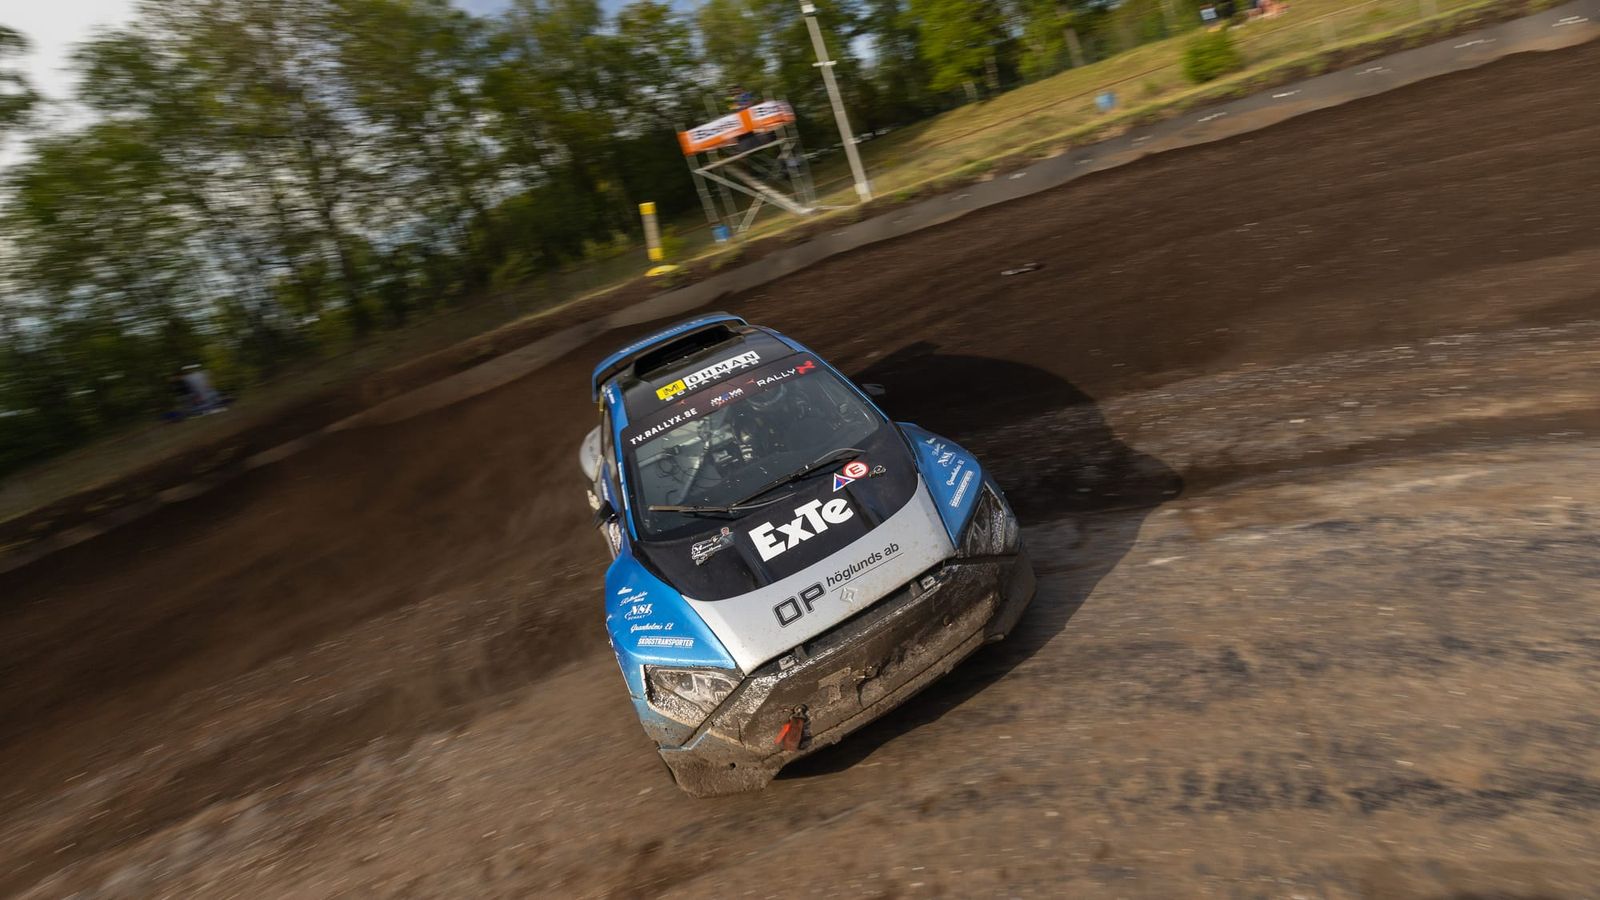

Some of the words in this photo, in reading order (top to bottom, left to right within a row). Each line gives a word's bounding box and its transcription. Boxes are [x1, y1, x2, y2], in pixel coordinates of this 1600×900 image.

[630, 407, 698, 445] TV.RALLYX.SE
[748, 498, 854, 562] ExTe
[826, 552, 882, 587] höglunds
[883, 542, 899, 556] ab
[772, 582, 827, 628] OP
